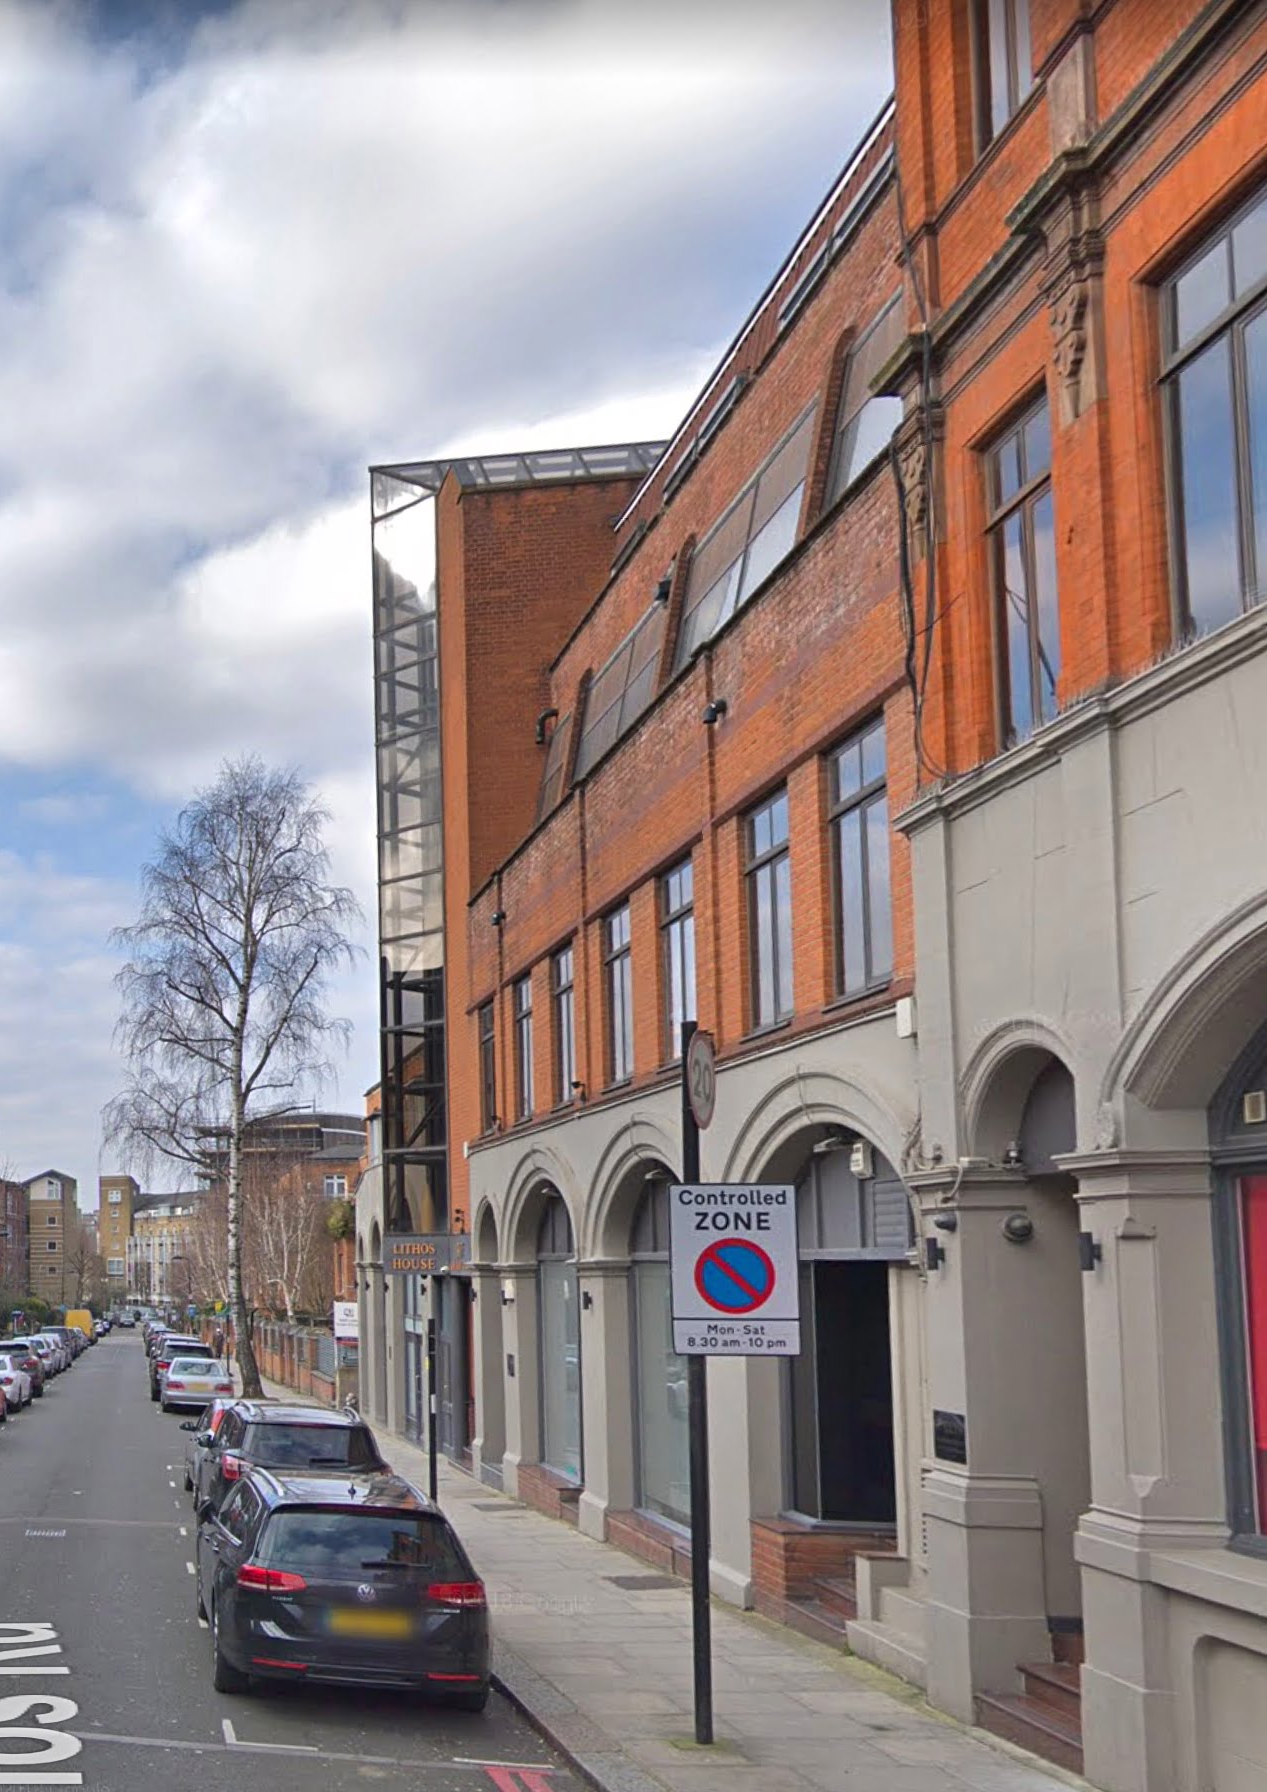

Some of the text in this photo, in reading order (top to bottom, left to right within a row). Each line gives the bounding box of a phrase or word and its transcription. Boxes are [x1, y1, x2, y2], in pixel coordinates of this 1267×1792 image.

[692, 1057, 712, 1102] 20
[678, 1189, 788, 1207] Controlled
[695, 1212, 772, 1232] ZONE
[393, 1243, 435, 1255] LITHOS
[392, 1258, 436, 1270] HOUSE
[687, 1336, 718, 1347] 8.30
[767, 1338, 787, 1349] pm
